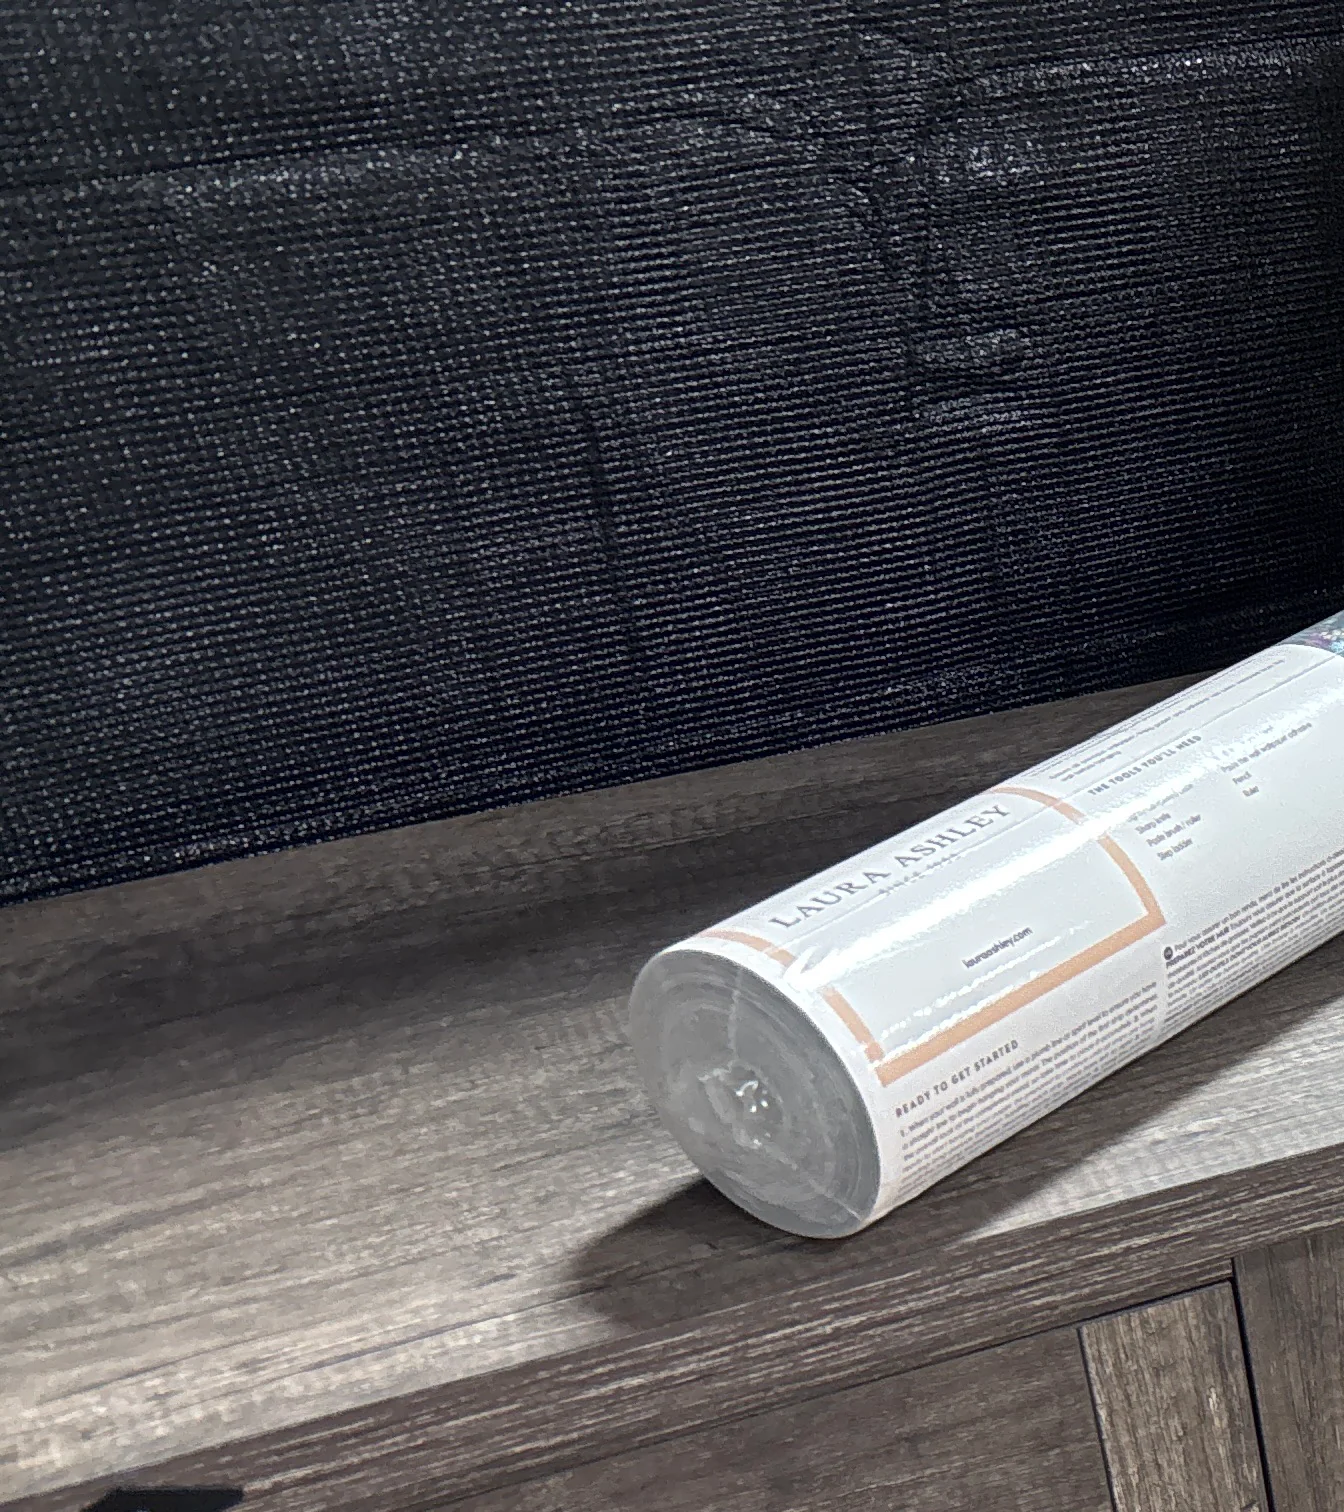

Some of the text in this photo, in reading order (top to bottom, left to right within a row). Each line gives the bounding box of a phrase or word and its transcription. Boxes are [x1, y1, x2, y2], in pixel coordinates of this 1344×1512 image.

[1088, 783, 1110, 795] THE
[1109, 767, 1142, 784] TOOLS
[1176, 736, 1201, 749] NEED
[770, 806, 1008, 927] LAURA ASHLEY
[896, 1040, 1018, 1117] READY TO GET STARTED
